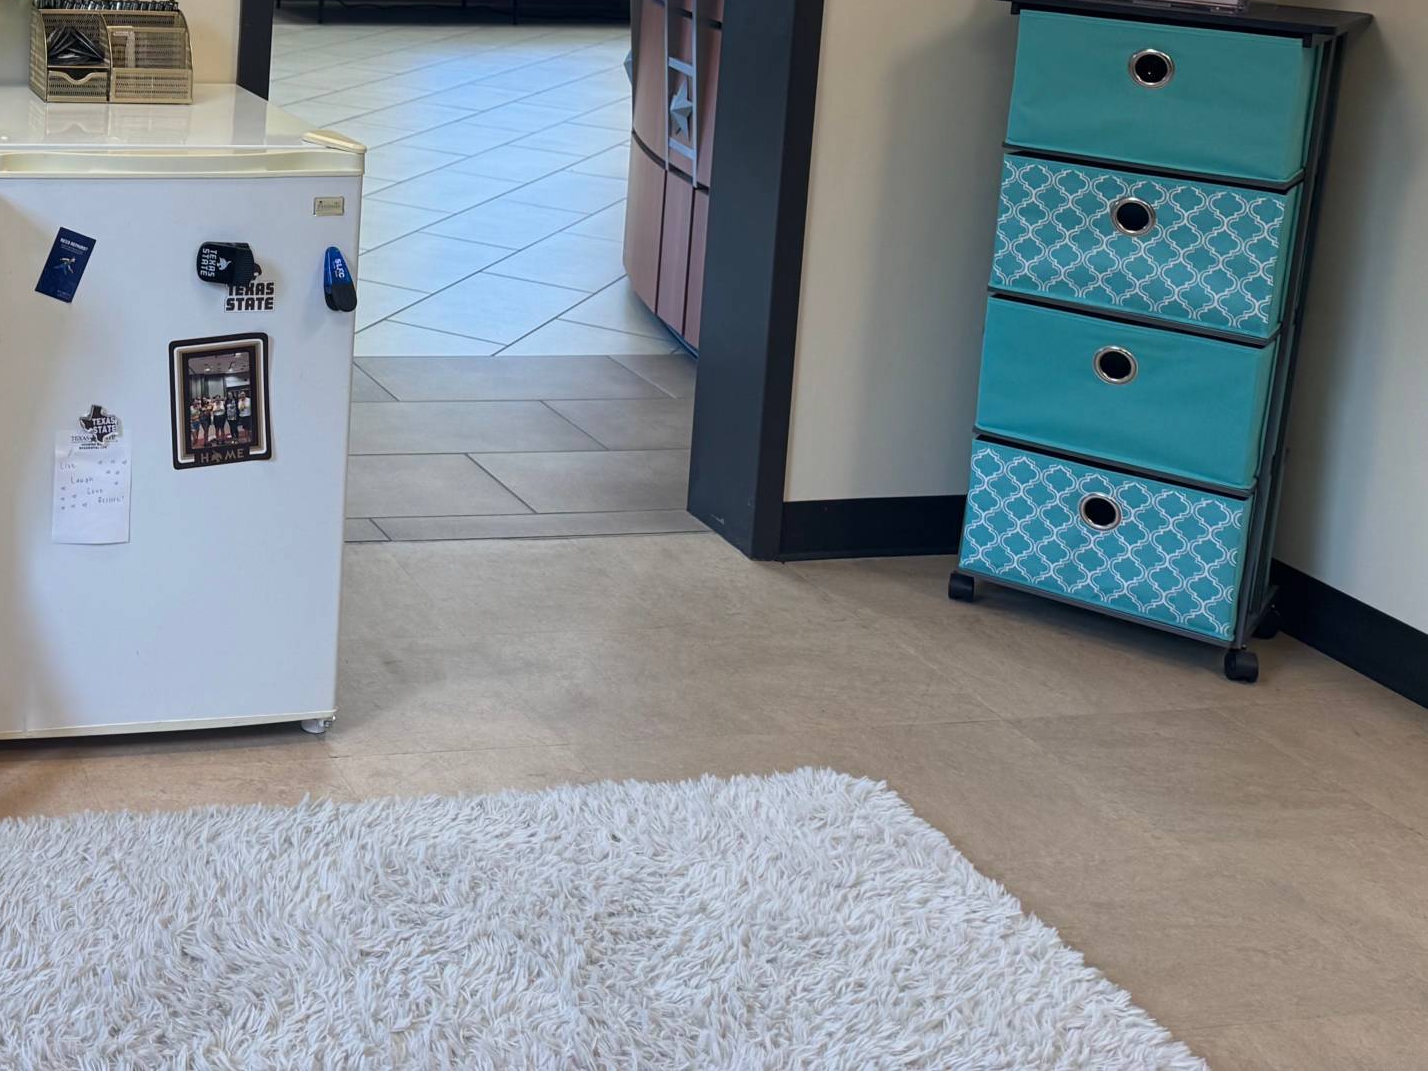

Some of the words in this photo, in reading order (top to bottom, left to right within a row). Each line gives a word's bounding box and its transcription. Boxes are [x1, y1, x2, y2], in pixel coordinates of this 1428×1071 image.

[200, 248, 210, 277] STATE
[207, 249, 218, 277] TEXAS
[228, 282, 275, 296] TEXAS
[225, 296, 274, 311] STATE
[92, 416, 117, 426] TEXAS
[92, 425, 117, 434] STATE
[200, 449, 245, 463] HME
